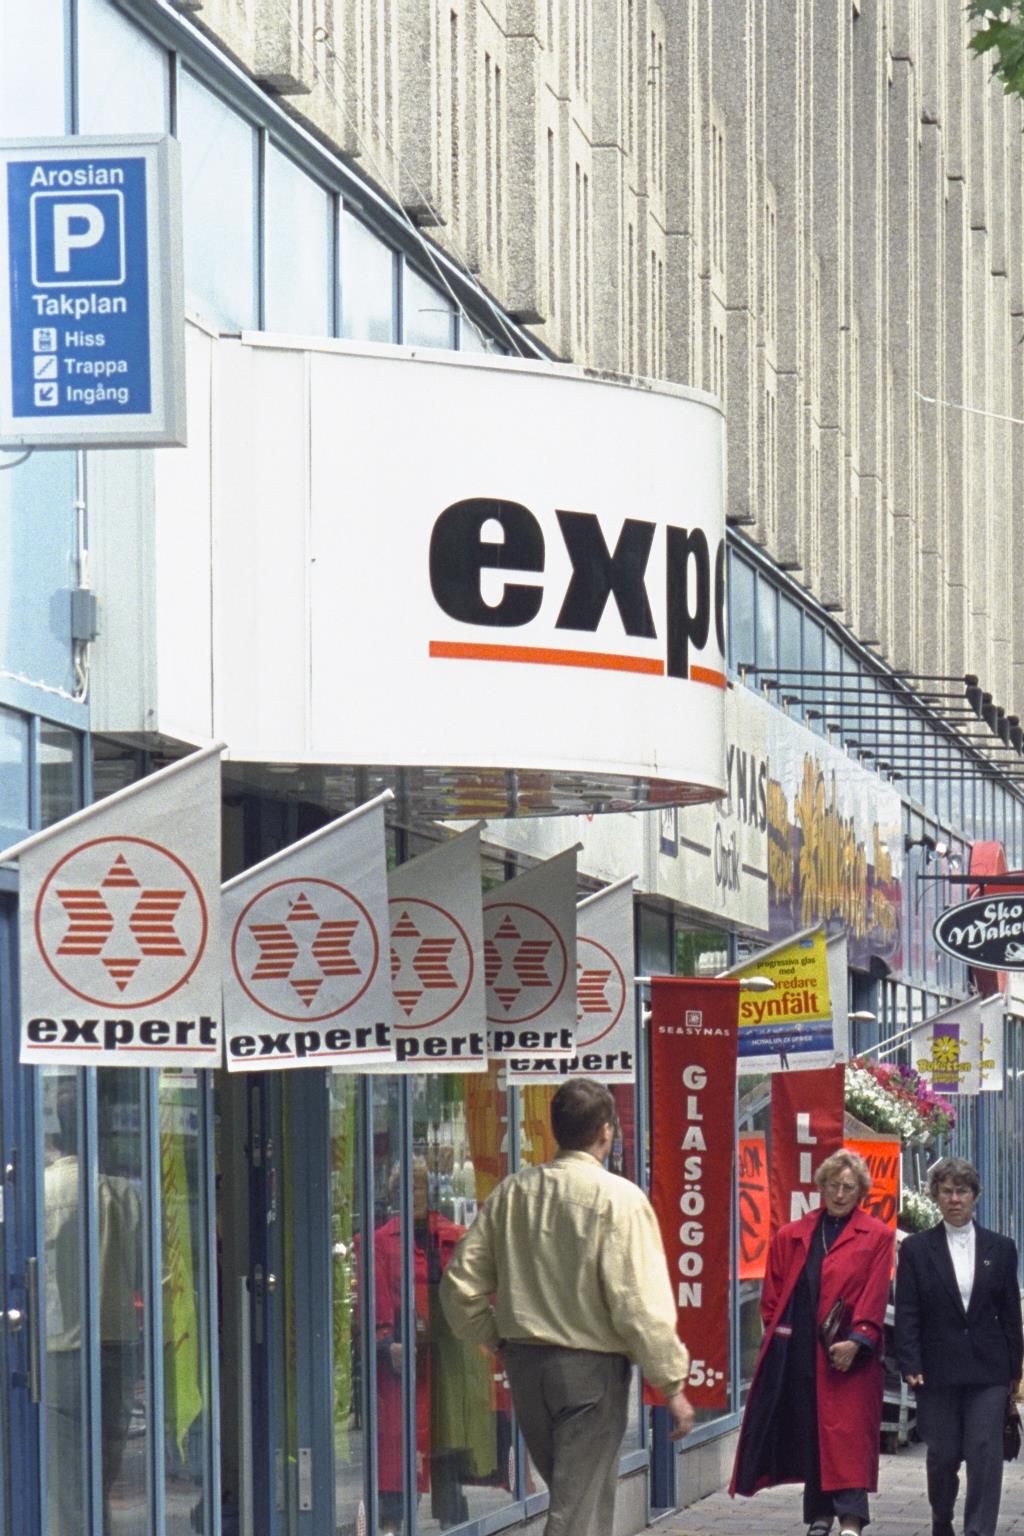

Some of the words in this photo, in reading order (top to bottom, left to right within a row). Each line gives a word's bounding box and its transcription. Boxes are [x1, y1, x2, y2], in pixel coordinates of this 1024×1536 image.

[30, 164, 124, 187] Arosian
[53, 203, 105, 273] P
[32, 294, 127, 320] Takplan
[65, 330, 105, 347] Hiss
[64, 358, 128, 377] Trappa
[66, 384, 129, 405] Ingång
[429, 497, 724, 680] exp
[716, 744, 767, 834] YNAS
[984, 902, 1023, 926] Sko
[741, 991, 820, 1025] synfält
[27, 1016, 217, 1050] expert
[229, 1022, 390, 1058] expert
[396, 1032, 484, 1061] pert
[487, 1029, 573, 1052] pert
[678, 1065, 708, 1307] GLASÖGON
